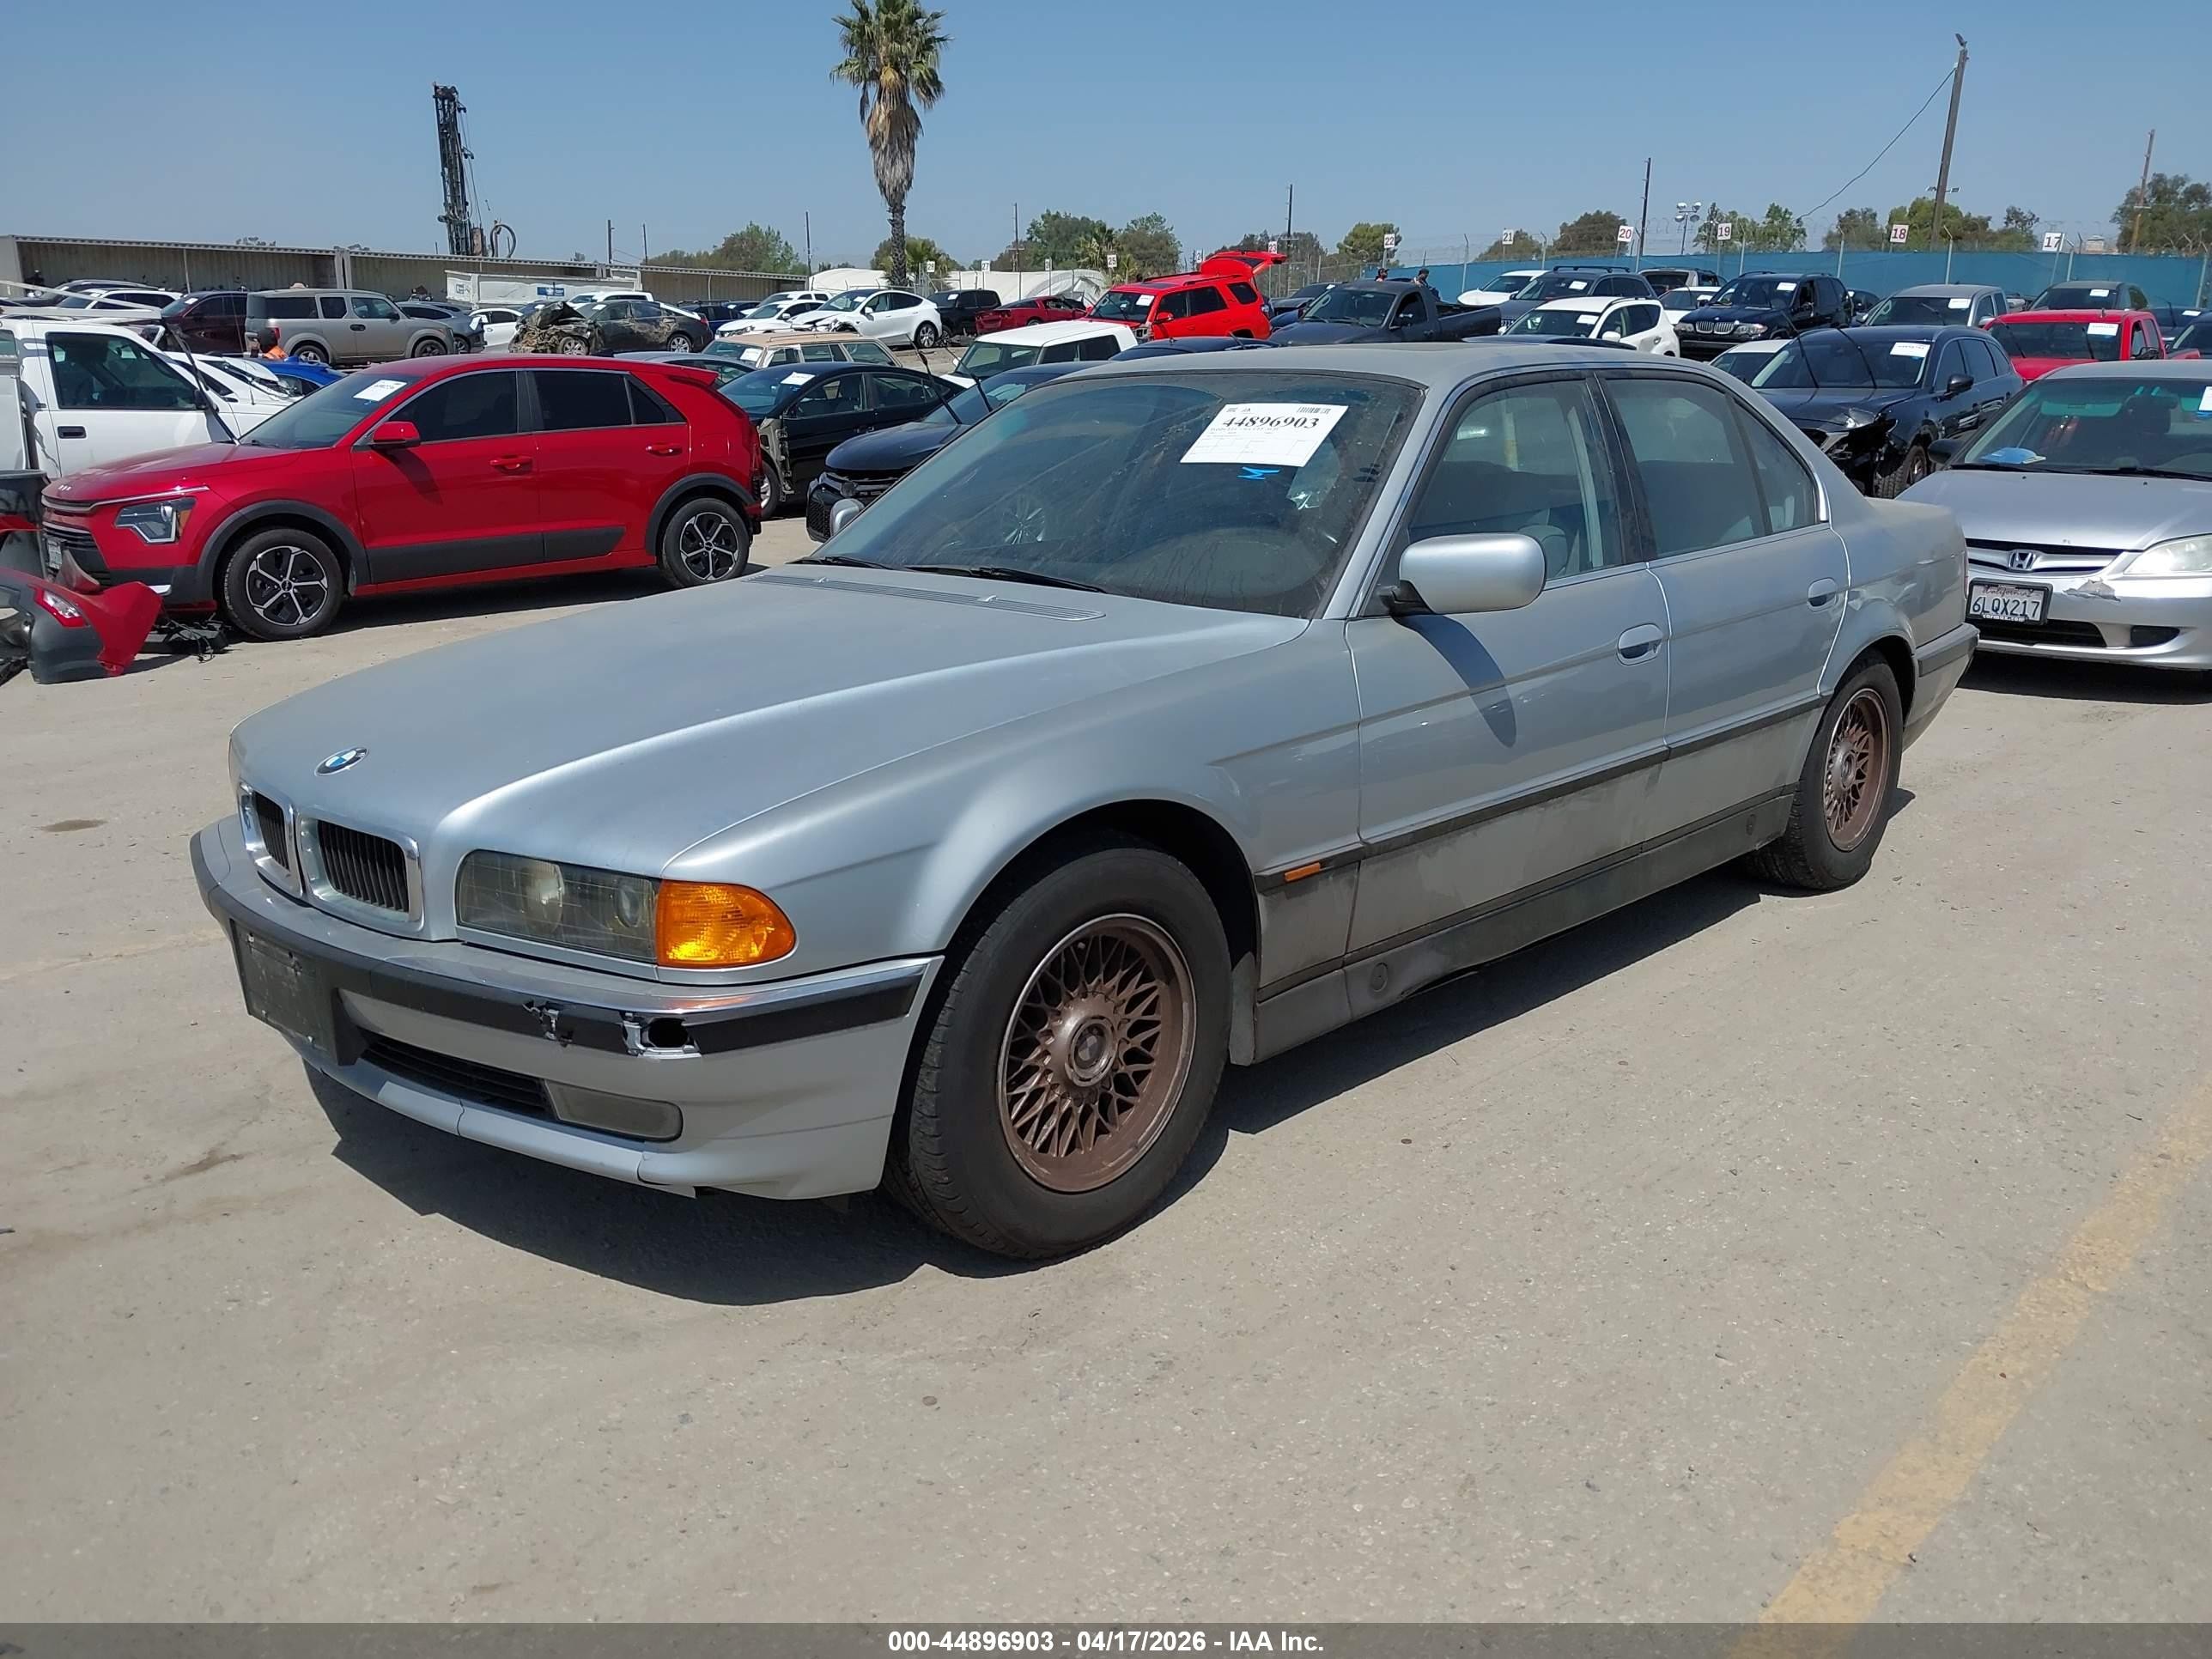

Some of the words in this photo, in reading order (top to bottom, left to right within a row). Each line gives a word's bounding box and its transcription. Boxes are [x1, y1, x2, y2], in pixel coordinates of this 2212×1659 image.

[1503, 232, 1512, 241] 21
[1619, 228, 1632, 239] 20
[1718, 226, 1730, 237] 19
[1892, 228, 1906, 239] 18
[1384, 236, 1394, 246] 22
[2044, 236, 2061, 247] 17
[1268, 243, 1277, 252] 23
[981, 262, 989, 270] 27
[1223, 416, 1320, 428] 44896903
[1972, 596, 2040, 617] 6LQX217
